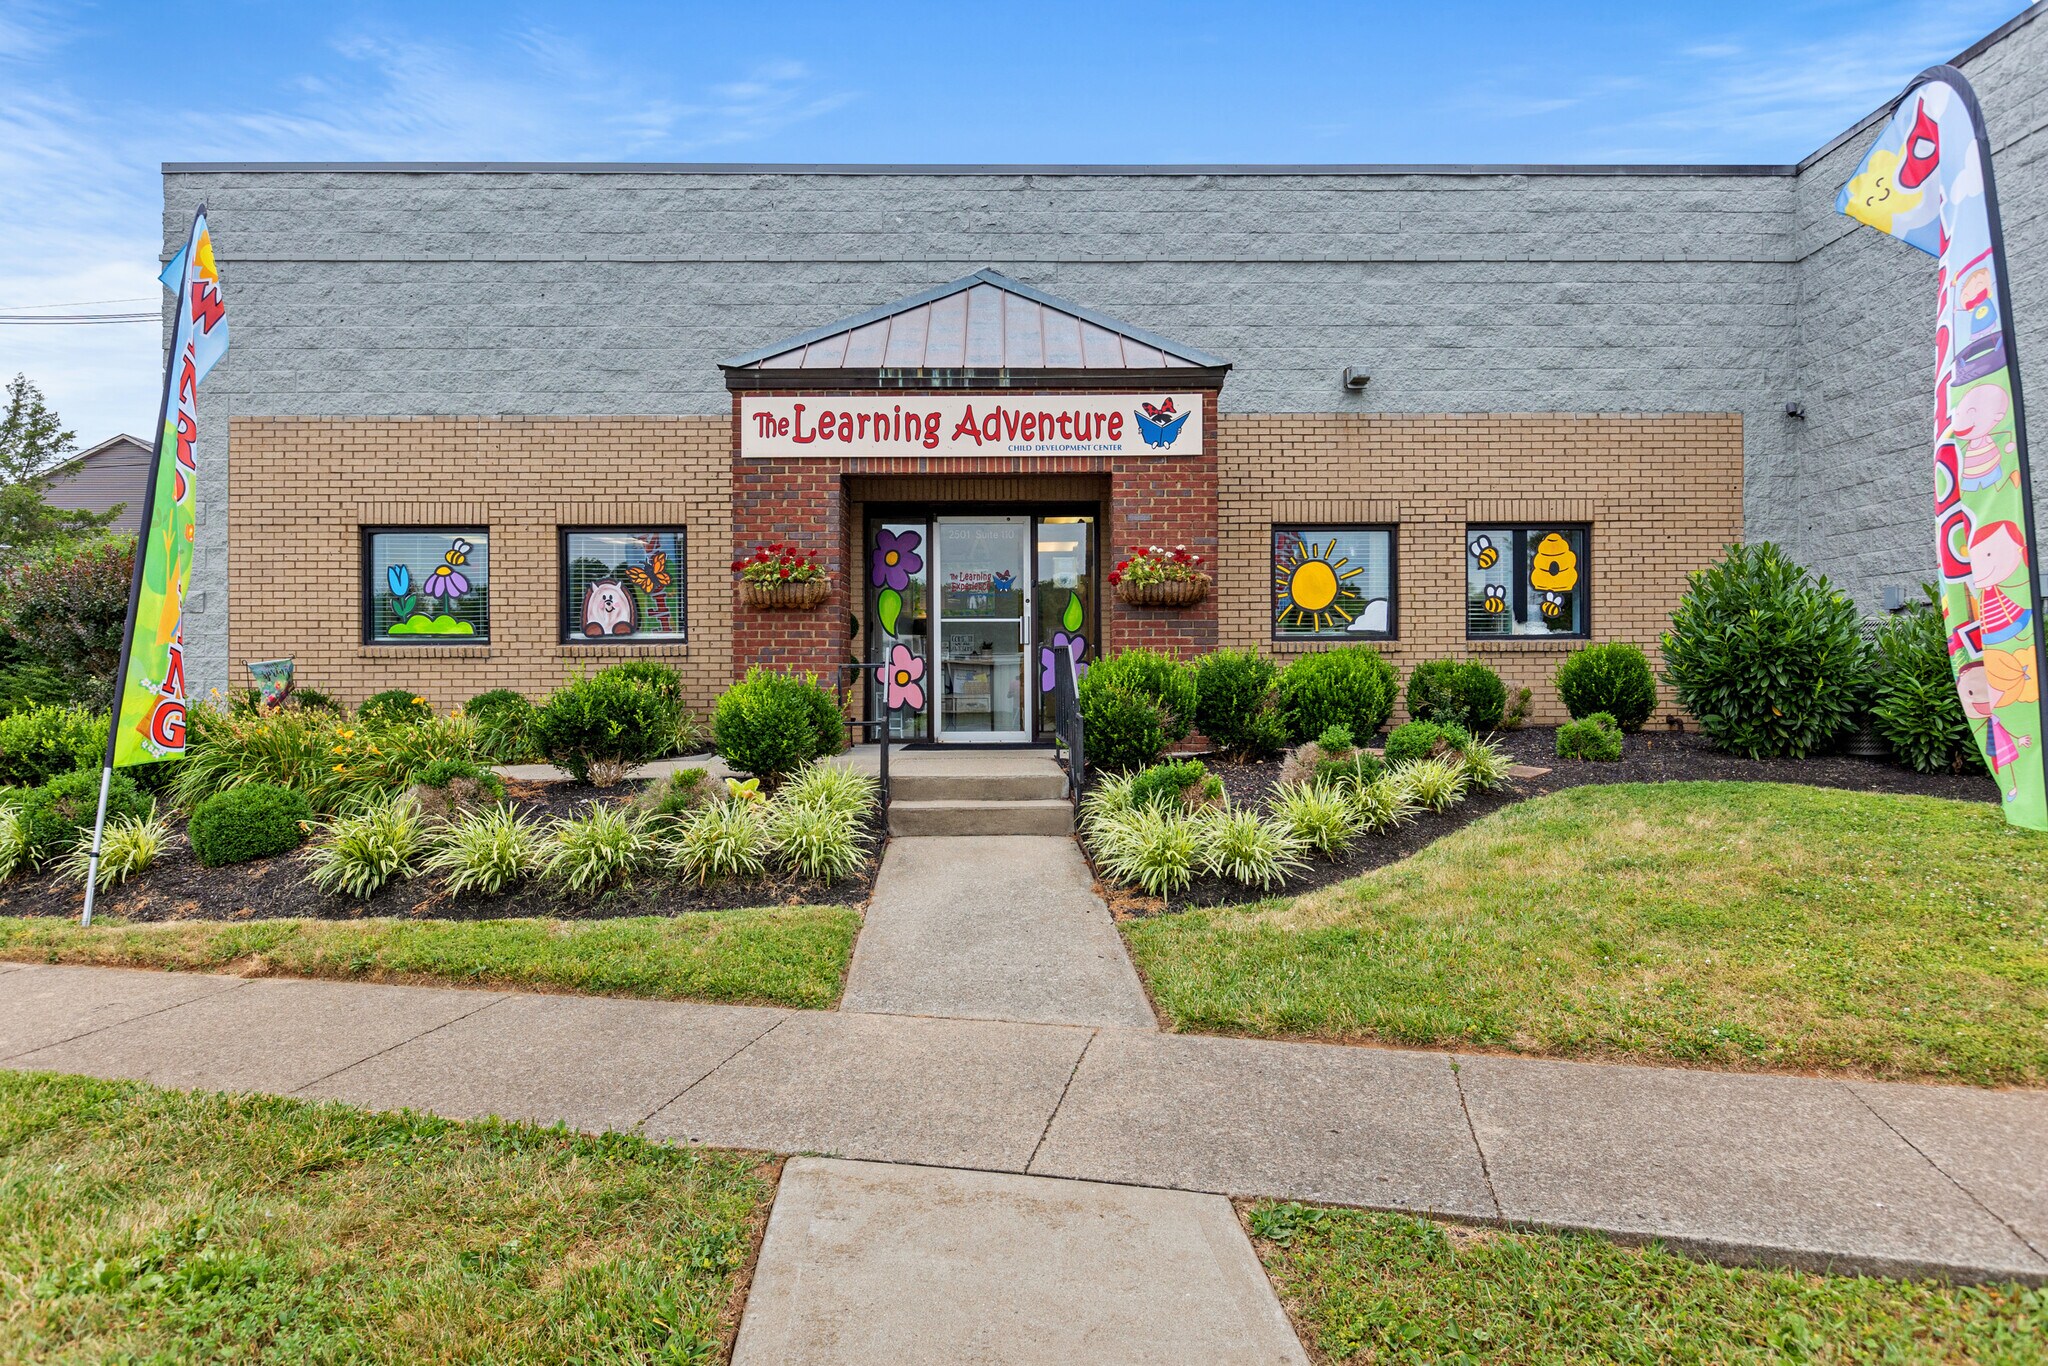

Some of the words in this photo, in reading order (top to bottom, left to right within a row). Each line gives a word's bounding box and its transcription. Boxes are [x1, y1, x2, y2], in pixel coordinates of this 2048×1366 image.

[752, 411, 790, 438] The
[791, 403, 942, 449] Learning
[951, 404, 1124, 447] Adventure
[1008, 444, 1032, 452] CHILD
[1035, 443, 1092, 452] DEVELOPMENT
[1093, 443, 1123, 451] CENTER
[948, 530, 970, 539] 2501
[975, 530, 999, 539] Suite
[1001, 530, 1015, 539] 110
[959, 571, 992, 582] Learning
[951, 582, 991, 592] Experience
